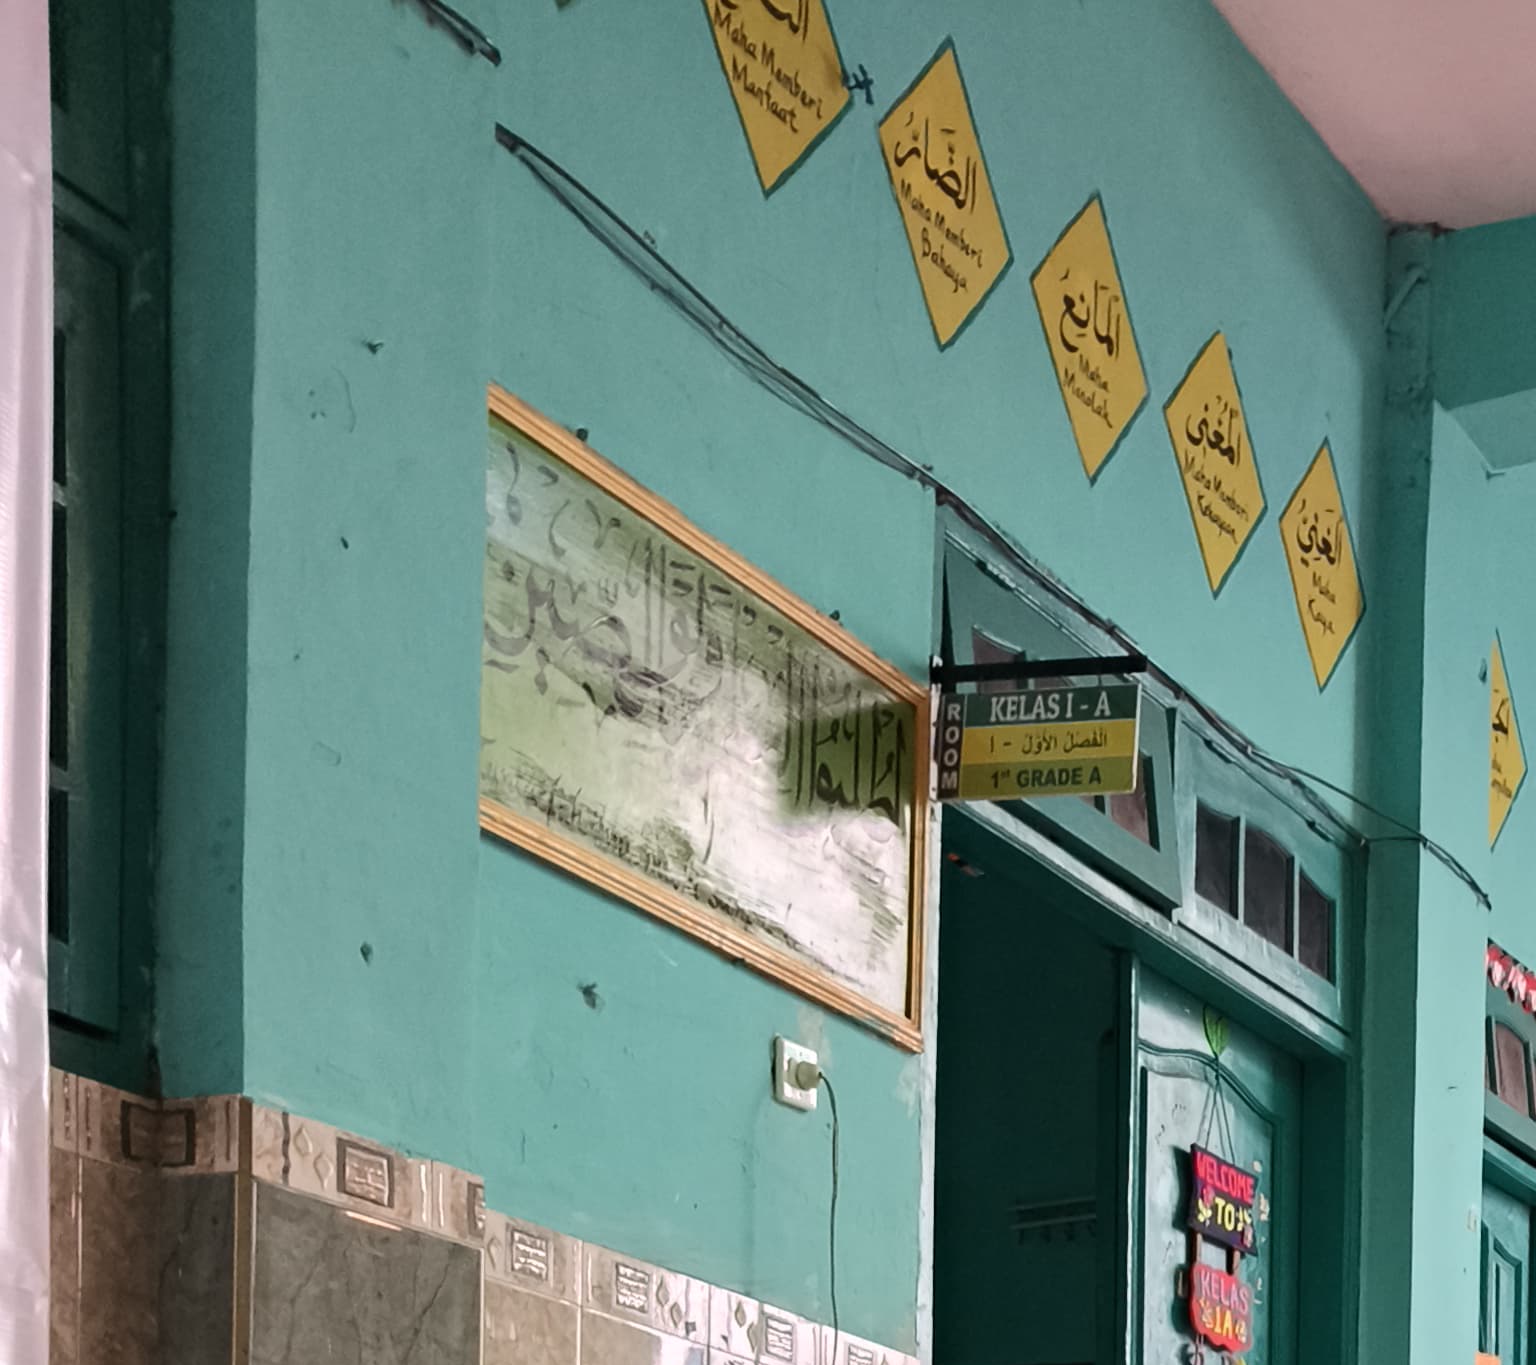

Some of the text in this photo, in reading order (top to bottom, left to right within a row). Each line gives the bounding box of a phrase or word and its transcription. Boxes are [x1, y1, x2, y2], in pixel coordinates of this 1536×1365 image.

[762, 42, 823, 119] Memberi
[990, 692, 1060, 722] KELAS
[1065, 692, 1075, 718] I
[1094, 690, 1111, 717] A
[941, 703, 961, 790] ROOM
[1016, 767, 1082, 788] GRADE
[1089, 766, 1101, 785] A
[1196, 1152, 1253, 1206] WELCOME
[1214, 1196, 1235, 1232] TO
[1200, 1270, 1249, 1316] KELAS
